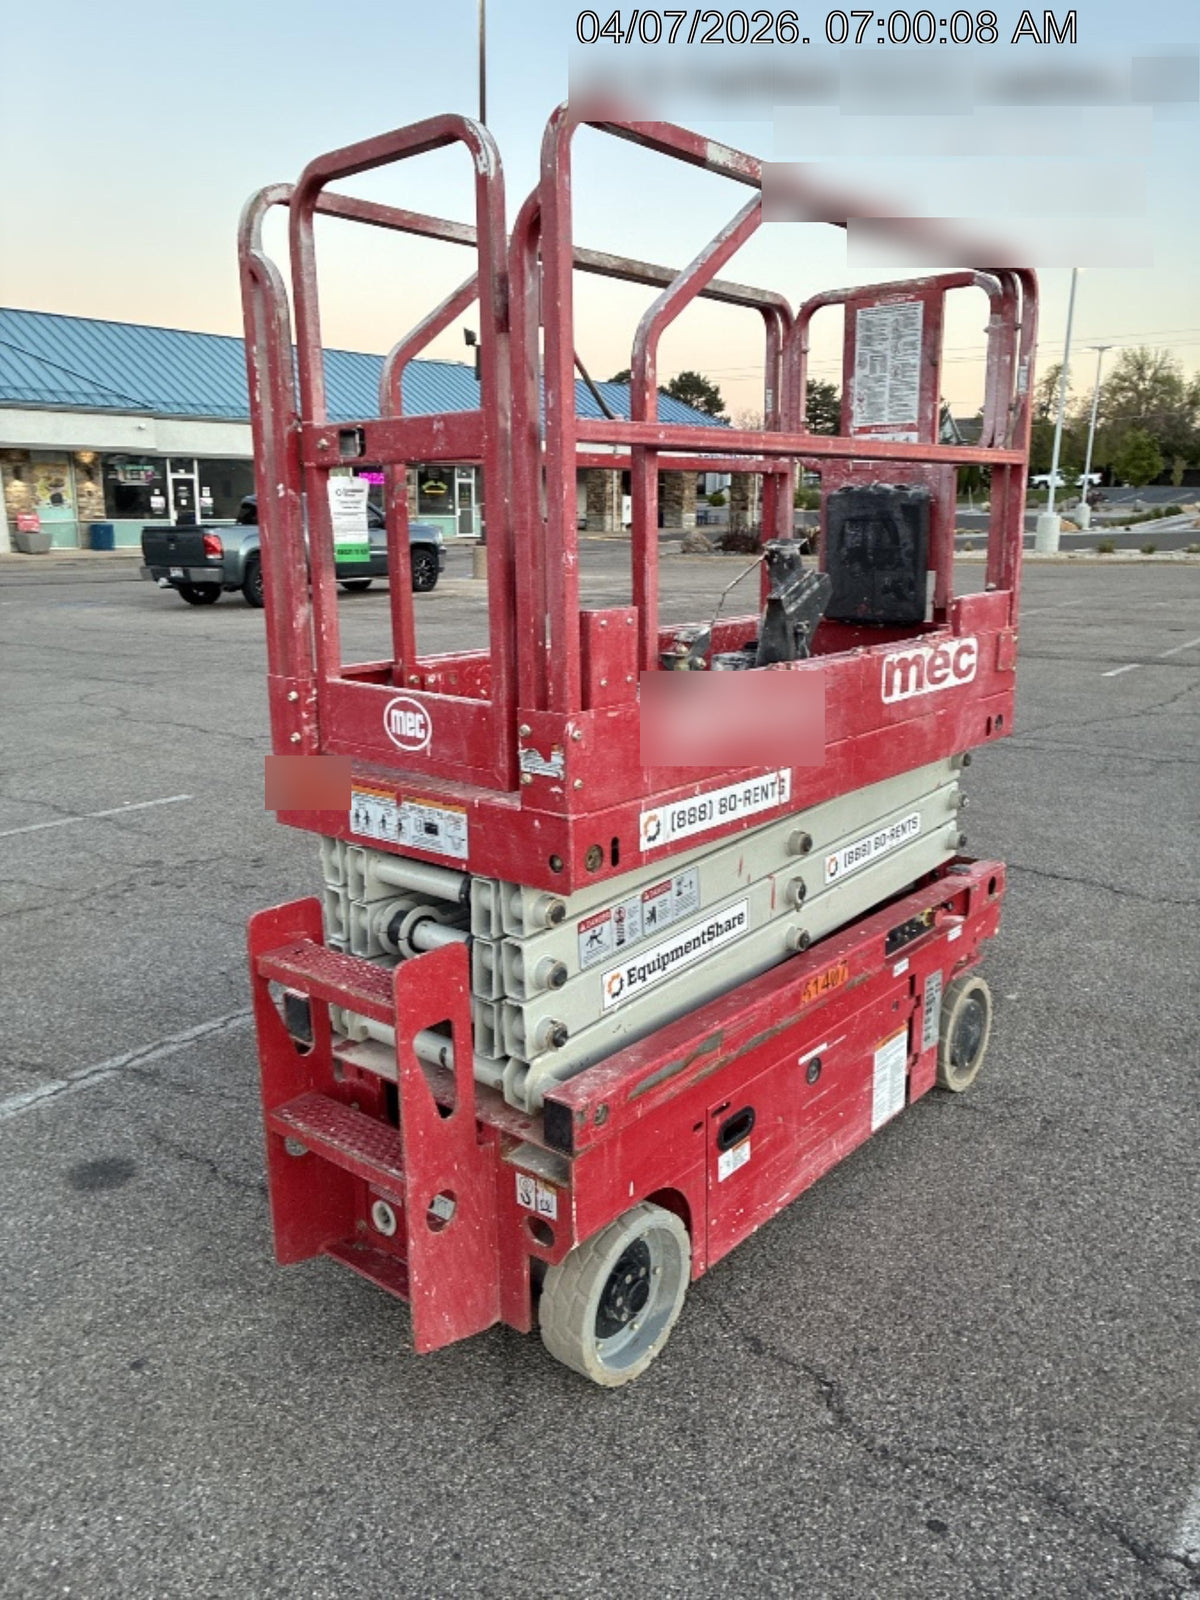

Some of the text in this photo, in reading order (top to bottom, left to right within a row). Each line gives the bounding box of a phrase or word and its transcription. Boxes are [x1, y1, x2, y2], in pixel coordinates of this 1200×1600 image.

[885, 645, 975, 698] mec
[671, 800, 714, 832] (888)
[626, 912, 745, 987] EquipmentShare
